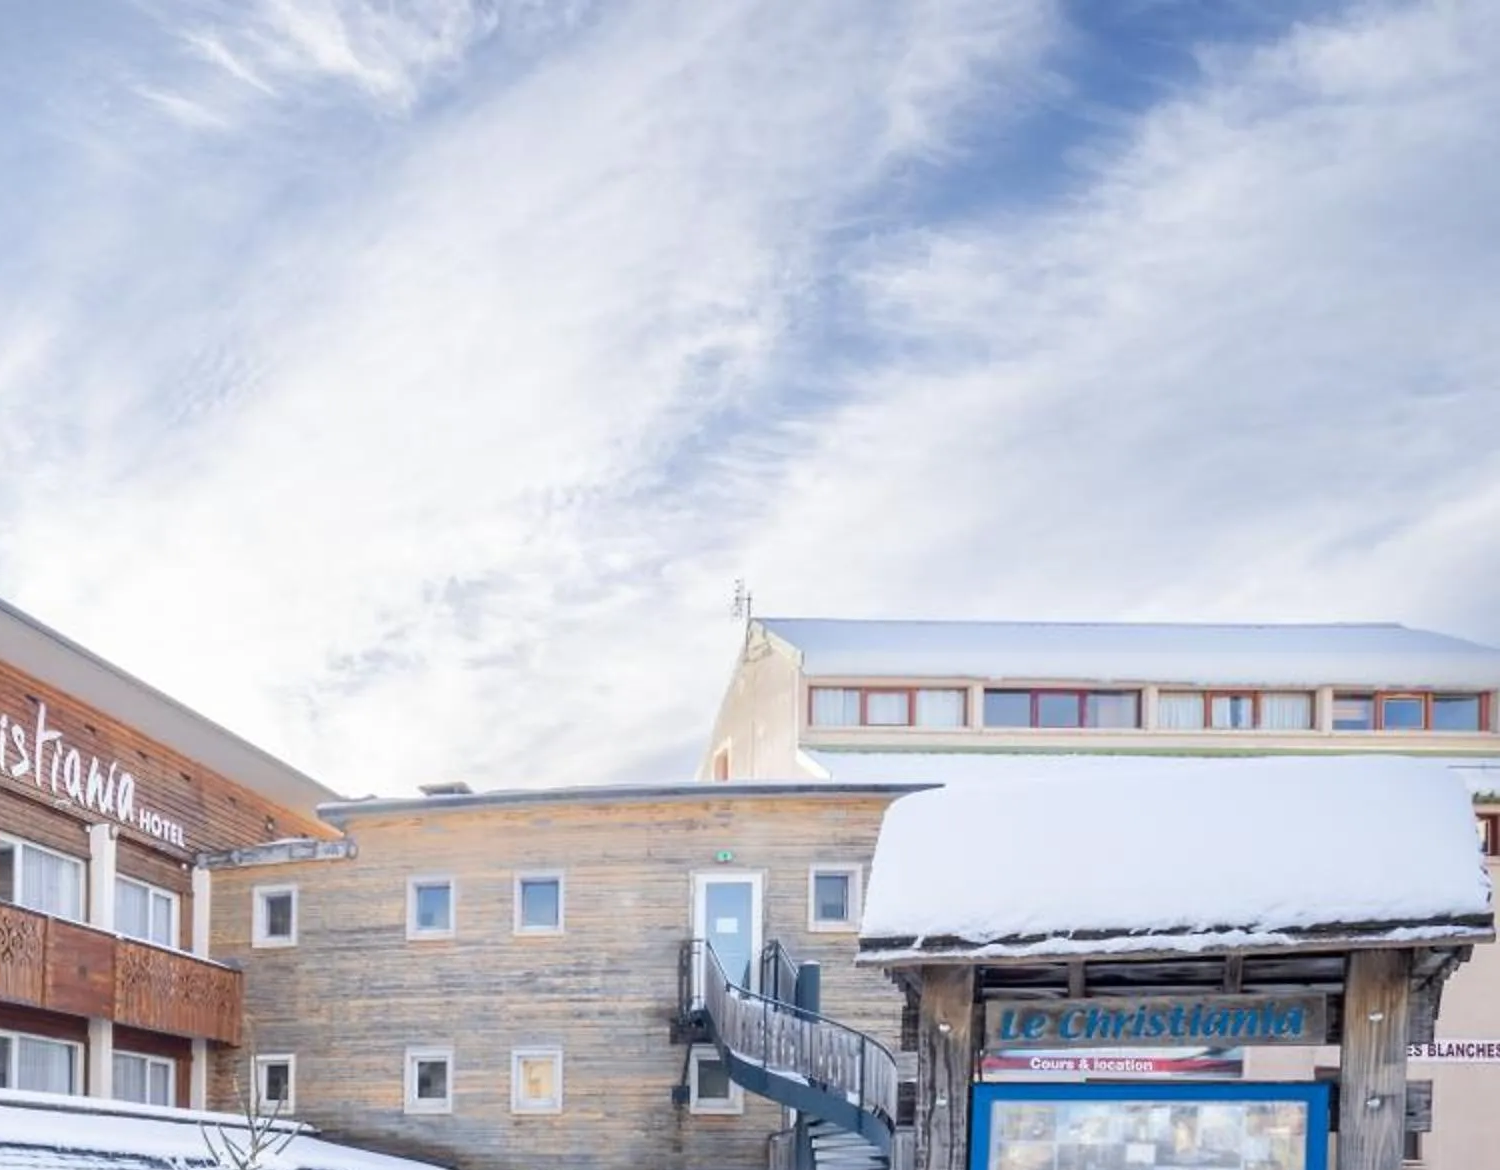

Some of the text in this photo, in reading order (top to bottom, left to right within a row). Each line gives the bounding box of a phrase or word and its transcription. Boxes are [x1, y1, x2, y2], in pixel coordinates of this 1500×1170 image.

[139, 807, 186, 848] HOTEL
[1001, 1000, 1307, 1041] Le Christiania
[1030, 1056, 1154, 1074] Cours & location
